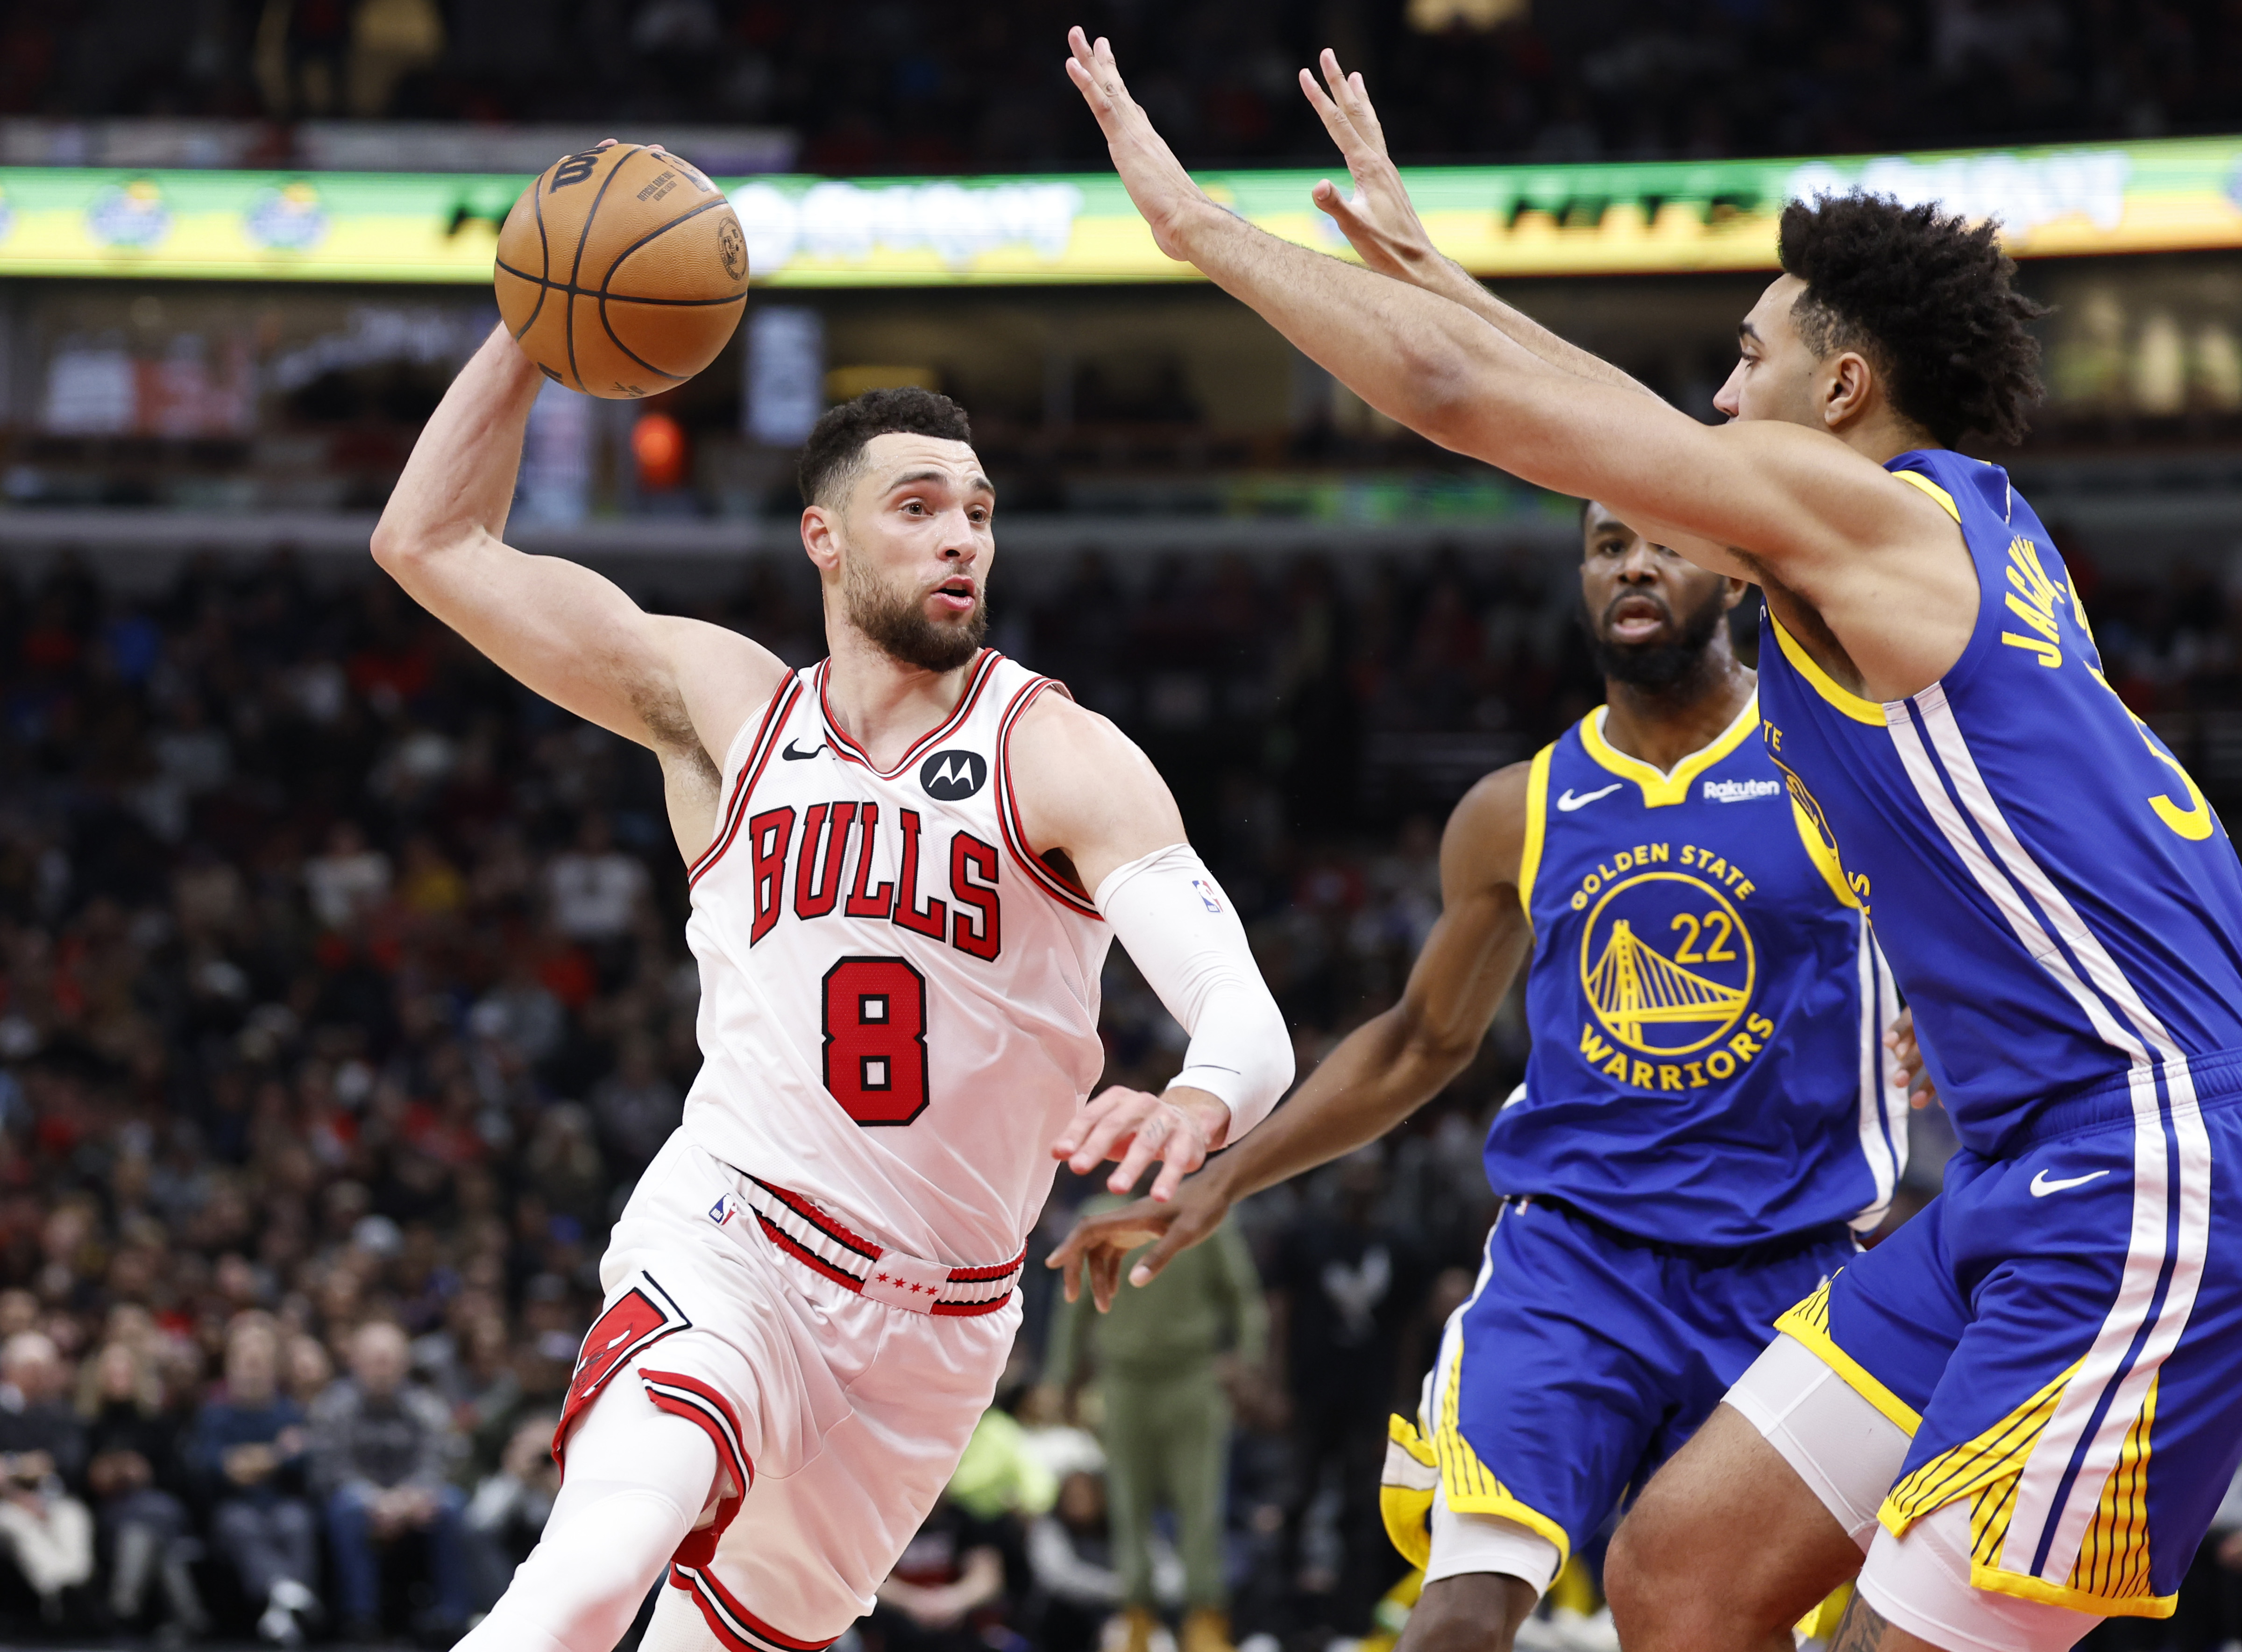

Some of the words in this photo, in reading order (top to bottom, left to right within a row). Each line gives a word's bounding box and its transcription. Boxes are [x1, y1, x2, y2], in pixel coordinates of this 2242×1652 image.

[1703, 779, 1781, 800] Rakuten
[749, 801, 1001, 963] BULLS
[1571, 843, 1669, 911] GOLDEN
[1680, 845, 1756, 901] STATE
[1670, 910, 1737, 964] 22
[821, 956, 930, 1127] 8
[1580, 1012, 1775, 1091] WARRIORS
